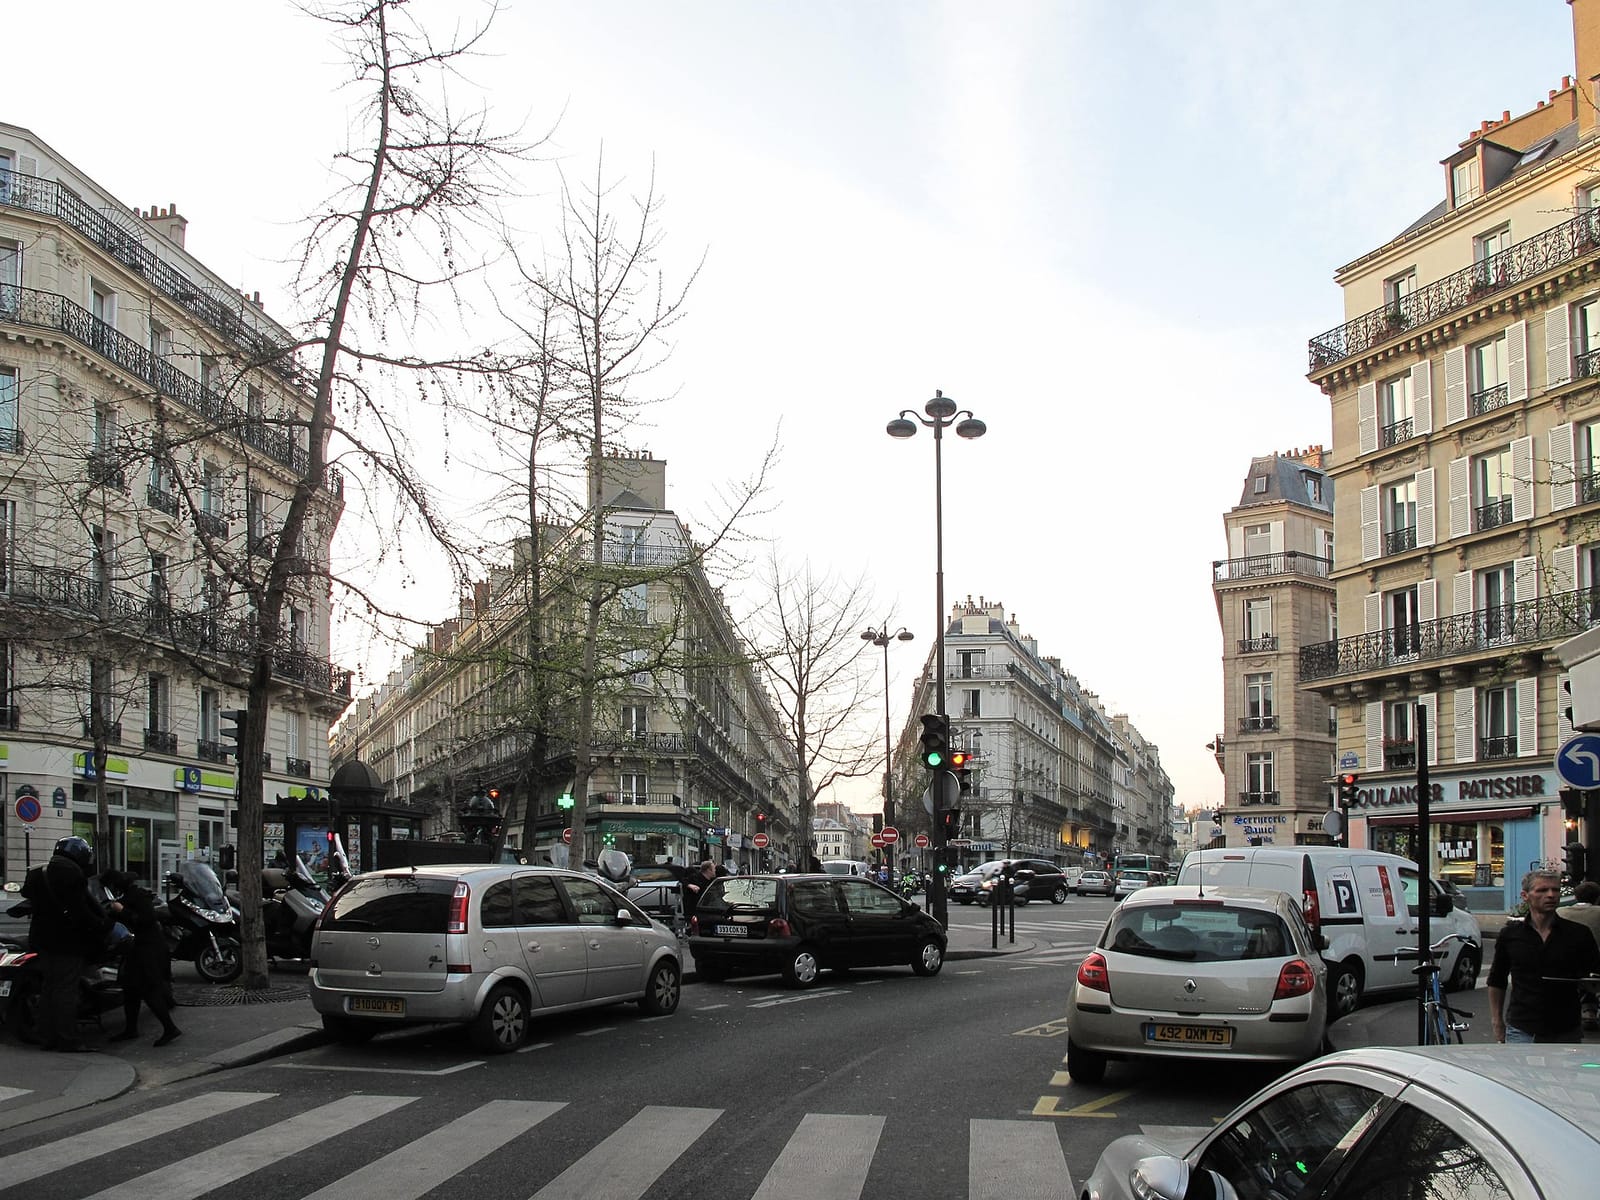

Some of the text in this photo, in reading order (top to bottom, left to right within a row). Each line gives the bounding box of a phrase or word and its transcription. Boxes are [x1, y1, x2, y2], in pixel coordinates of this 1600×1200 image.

[1356, 775, 1544, 807] OULANGR PATISSIER
[1243, 825, 1276, 835] Daniel
[388, 1000, 400, 1011] 75
[1160, 1026, 1224, 1042] 492 QXM 75
